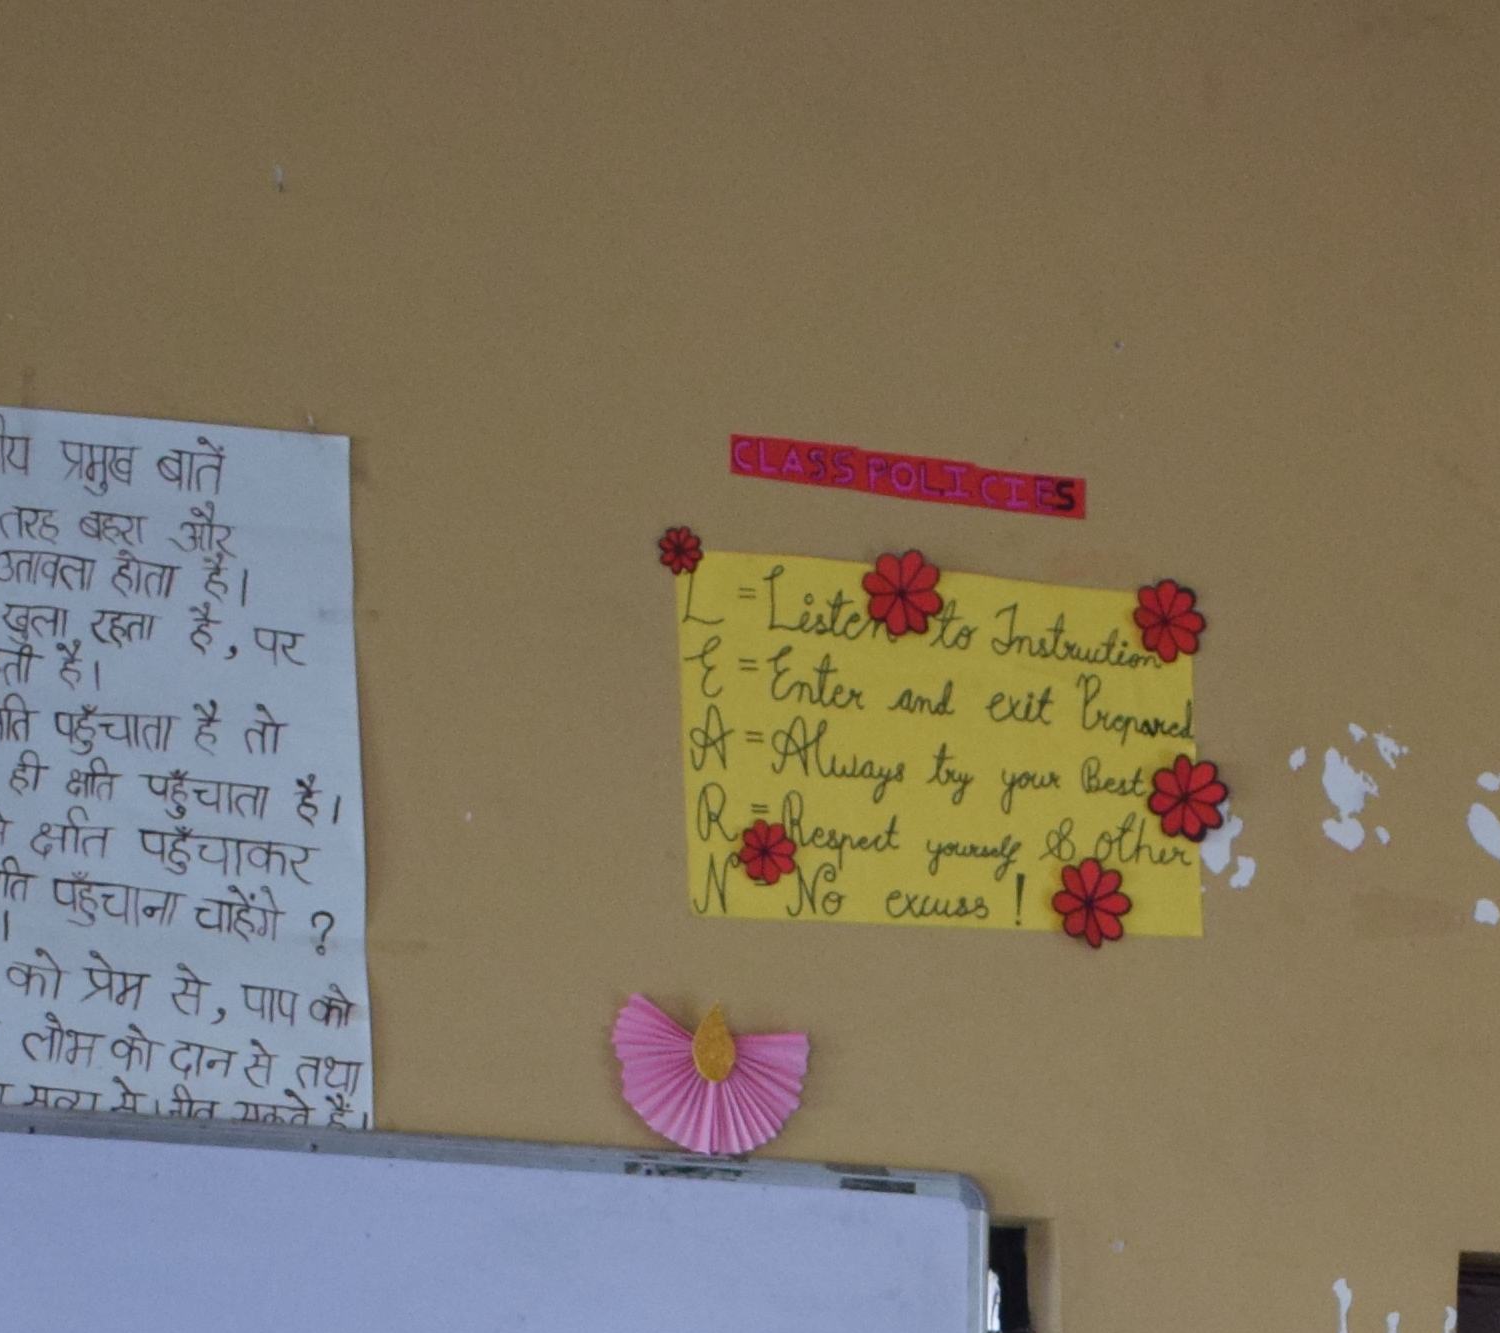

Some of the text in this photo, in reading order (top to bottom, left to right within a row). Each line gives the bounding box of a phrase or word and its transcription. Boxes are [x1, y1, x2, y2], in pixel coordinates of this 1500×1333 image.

[60, 439, 142, 496] प्रमुख
[157, 436, 225, 494] बातें
[732, 440, 1076, 512] CLASS POLICIES
[0, 505, 60, 544] तरह
[79, 510, 149, 546] बहरा
[169, 501, 237, 558] और
[110, 548, 182, 598] होता
[2, 603, 69, 644] खुला
[90, 609, 162, 649] रहता
[253, 626, 307, 667] पर
[929, 599, 977, 650] to
[767, 645, 865, 710] Enter
[888, 679, 954, 715] and
[985, 685, 1054, 726] exit
[54, 704, 181, 755] पहुँचाता
[194, 699, 222, 756] है
[244, 703, 290, 755] तो
[689, 703, 1148, 815] A Always try your Best
[8, 750, 51, 796] ही
[65, 757, 123, 802] क्षति
[138, 769, 271, 820] पहुँचाता
[30, 805, 115, 858] क्षति
[138, 826, 321, 885] पहुँचाकर
[697, 781, 739, 841] R
[782, 789, 899, 870] Respect
[926, 834, 1022, 882] yourself
[693, 851, 741, 914] N
[786, 862, 846, 917] No
[5, 947, 70, 1000] को
[81, 950, 151, 1011] प्रेम
[240, 984, 300, 1027] पाप
[309, 983, 356, 1028] को
[111, 1023, 165, 1072] को
[170, 1039, 238, 1081] दान
[244, 1039, 278, 1089] से
[296, 1054, 365, 1096] तथा
